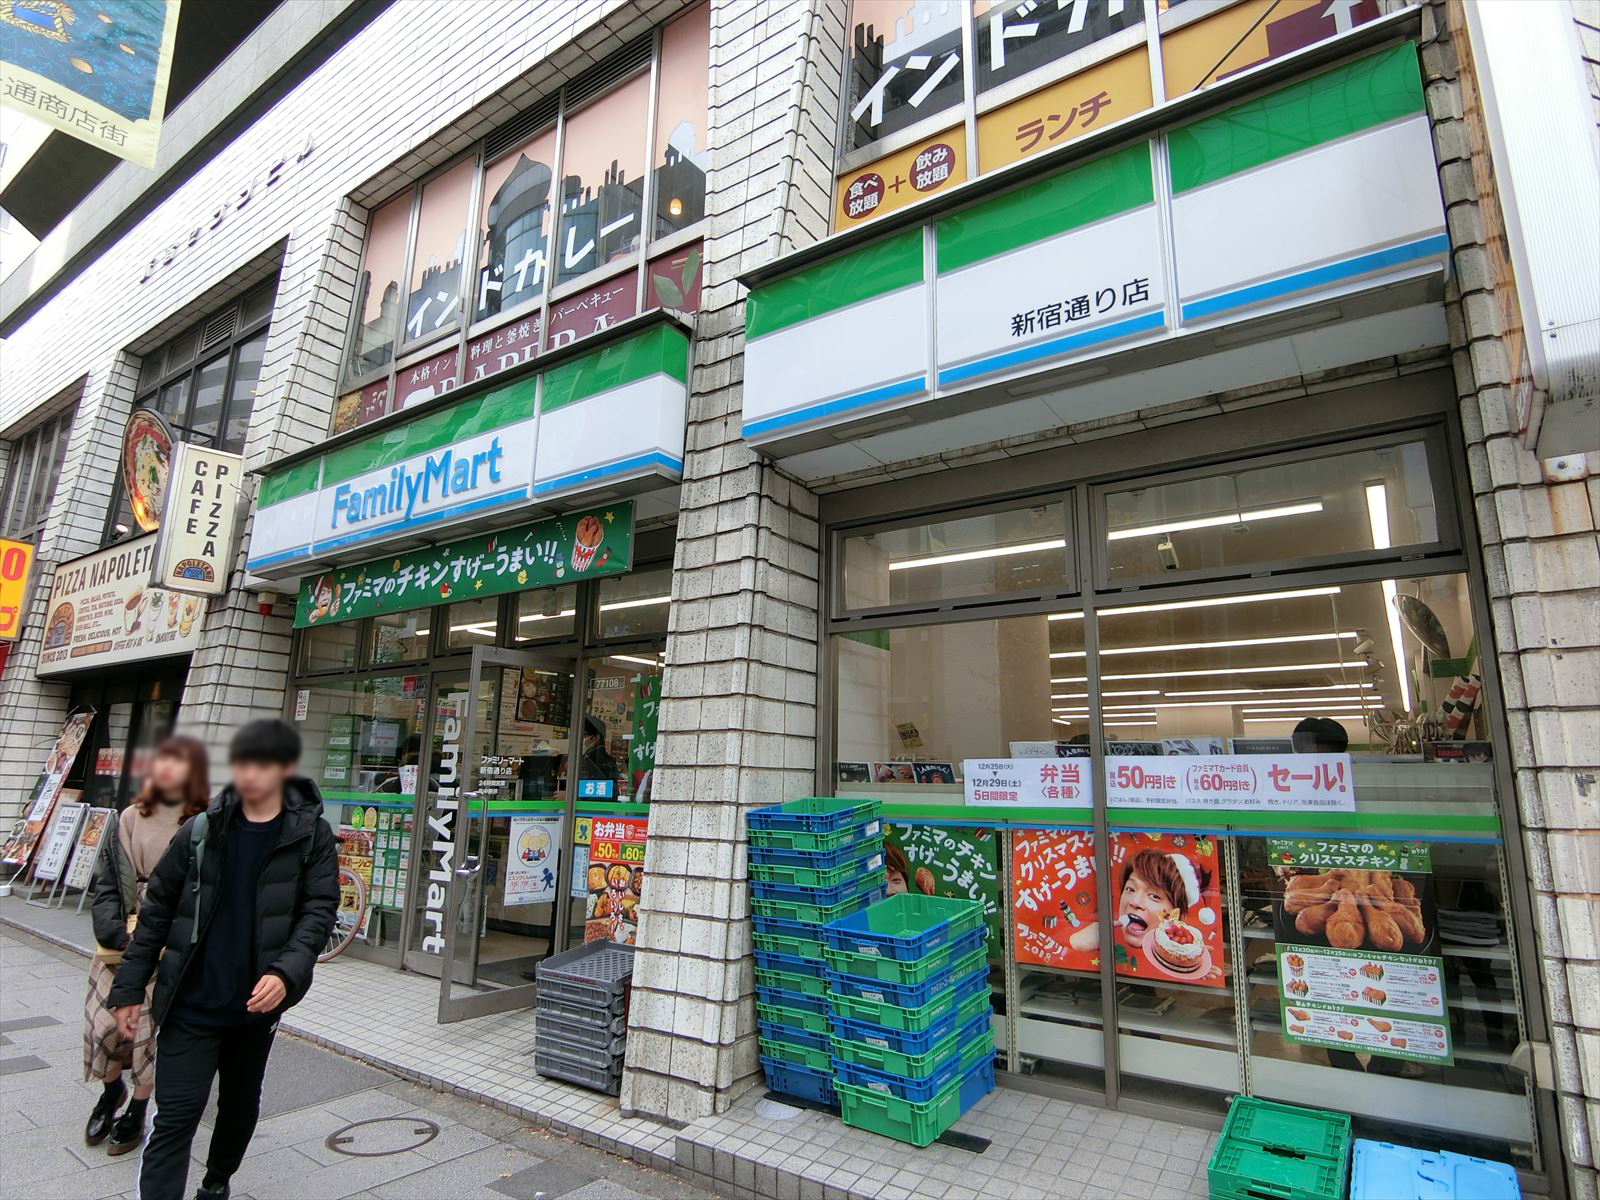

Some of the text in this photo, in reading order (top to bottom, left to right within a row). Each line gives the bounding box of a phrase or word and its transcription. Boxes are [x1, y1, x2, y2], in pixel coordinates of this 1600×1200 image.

[1015, 91, 1111, 153] ランチ
[915, 147, 948, 172] 飲み
[849, 175, 879, 200] 食べ
[915, 163, 949, 190] 放題
[849, 192, 879, 217] 放題
[407, 213, 634, 338] インドカレー
[1011, 277, 1150, 337] 新宿通り店
[331, 435, 504, 530] FamilyMart
[187, 460, 208, 534] CAFE
[202, 464, 229, 557] PIZZA
[53, 566, 86, 599] PIZZA
[596, 679, 619, 688] 77108
[480, 755, 525, 765] ファミリーマート
[480, 766, 513, 775] 新宿通り店
[1192, 764, 1249, 772] ファミマTカード会員
[972, 779, 1022, 787] 12月29日(土)
[1040, 763, 1080, 783] 弁当
[1117, 765, 1177, 789] 50円引き
[1200, 774, 1250, 791] 60円引き
[1267, 762, 1346, 792] セール!
[585, 782, 607, 796] お酒
[974, 790, 1018, 801] 5日間限定
[594, 822, 625, 839] お弁当
[895, 823, 997, 881] ファミマのチキン
[1299, 853, 1396, 867] クリスマスチキン
[1316, 842, 1374, 854] ファミマの
[1024, 942, 1052, 964] 2018
